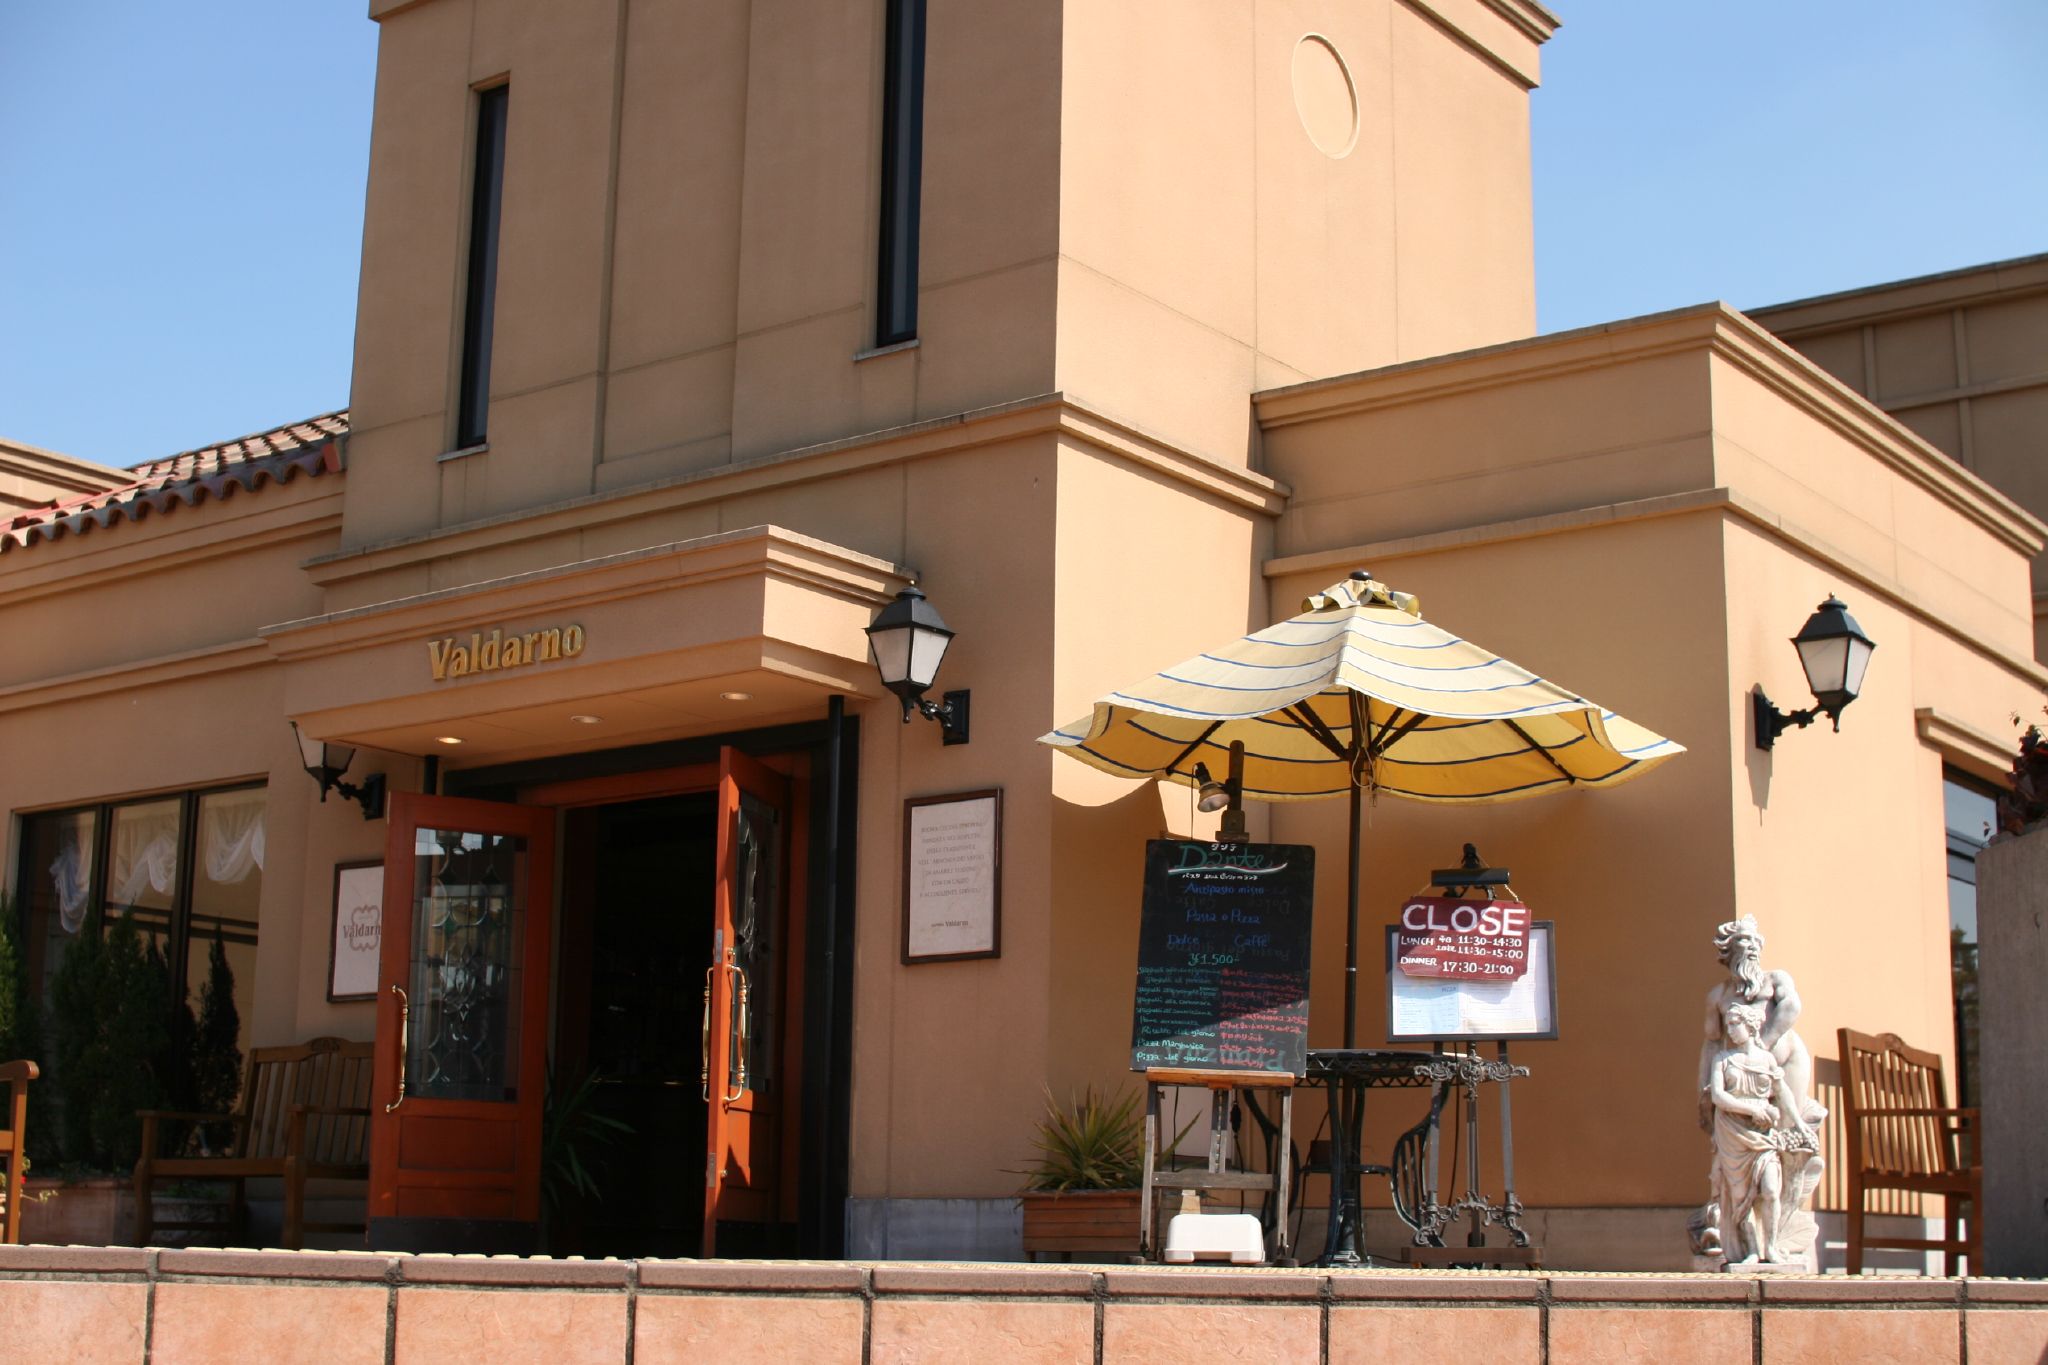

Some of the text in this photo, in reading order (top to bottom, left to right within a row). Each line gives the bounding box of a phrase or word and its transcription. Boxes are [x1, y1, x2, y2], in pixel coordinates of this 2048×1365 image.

[427, 624, 585, 680] Valdarno
[1174, 844, 1265, 869] Dante
[1186, 908, 1217, 923] Pasta
[1231, 907, 1261, 924] Pizza
[1402, 904, 1526, 936] CLOSE
[343, 923, 381, 938] Valdarn
[1168, 933, 1200, 945] Dolce
[1401, 935, 1434, 946] LUNCH
[1458, 935, 1522, 948] 11:30-14:30
[1458, 946, 1524, 959] 11:30-15:00
[1400, 956, 1514, 974] DINNER 17:30-21:00
[1136, 1052, 1160, 1062] Pizza
[1183, 1055, 1209, 1063] giorno
